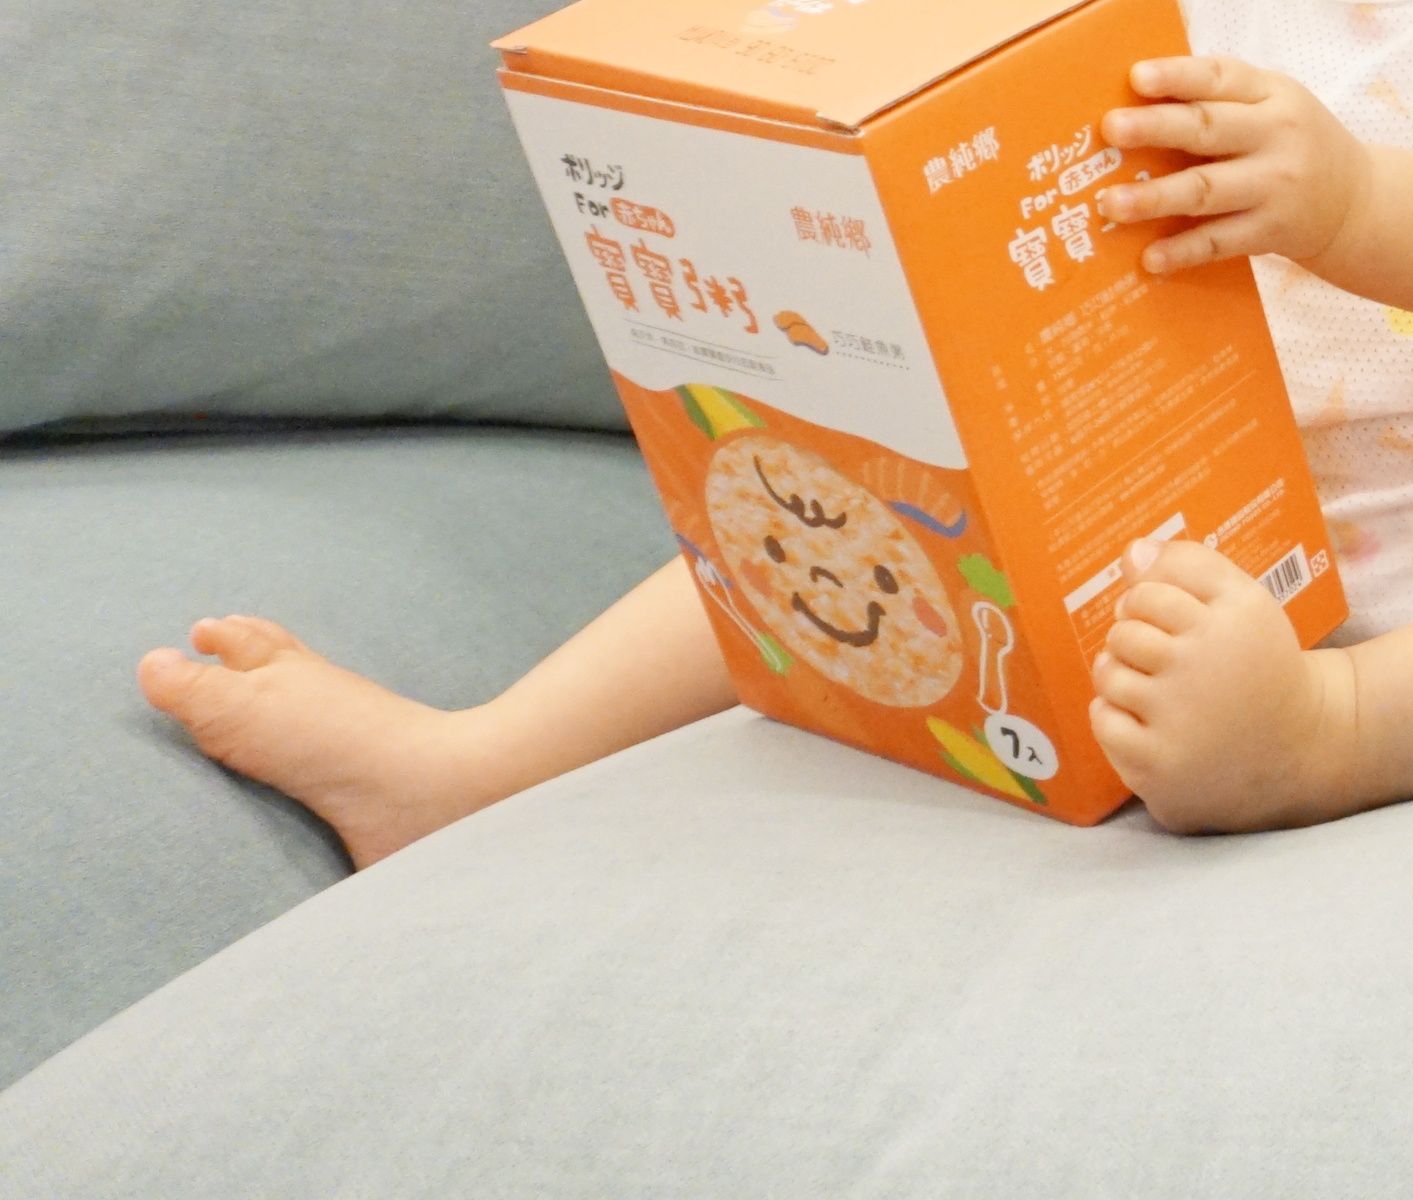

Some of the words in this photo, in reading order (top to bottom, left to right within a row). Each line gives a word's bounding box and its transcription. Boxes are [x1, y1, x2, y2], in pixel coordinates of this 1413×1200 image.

[923, 125, 1001, 194] 農純鄉
[1019, 187, 1058, 220] For
[1062, 148, 1120, 193] 赤ちゃん
[1026, 123, 1091, 182] ポリッジ
[573, 191, 610, 218] For
[790, 205, 872, 259] 農純鄉
[584, 224, 760, 334] 寶寶粥
